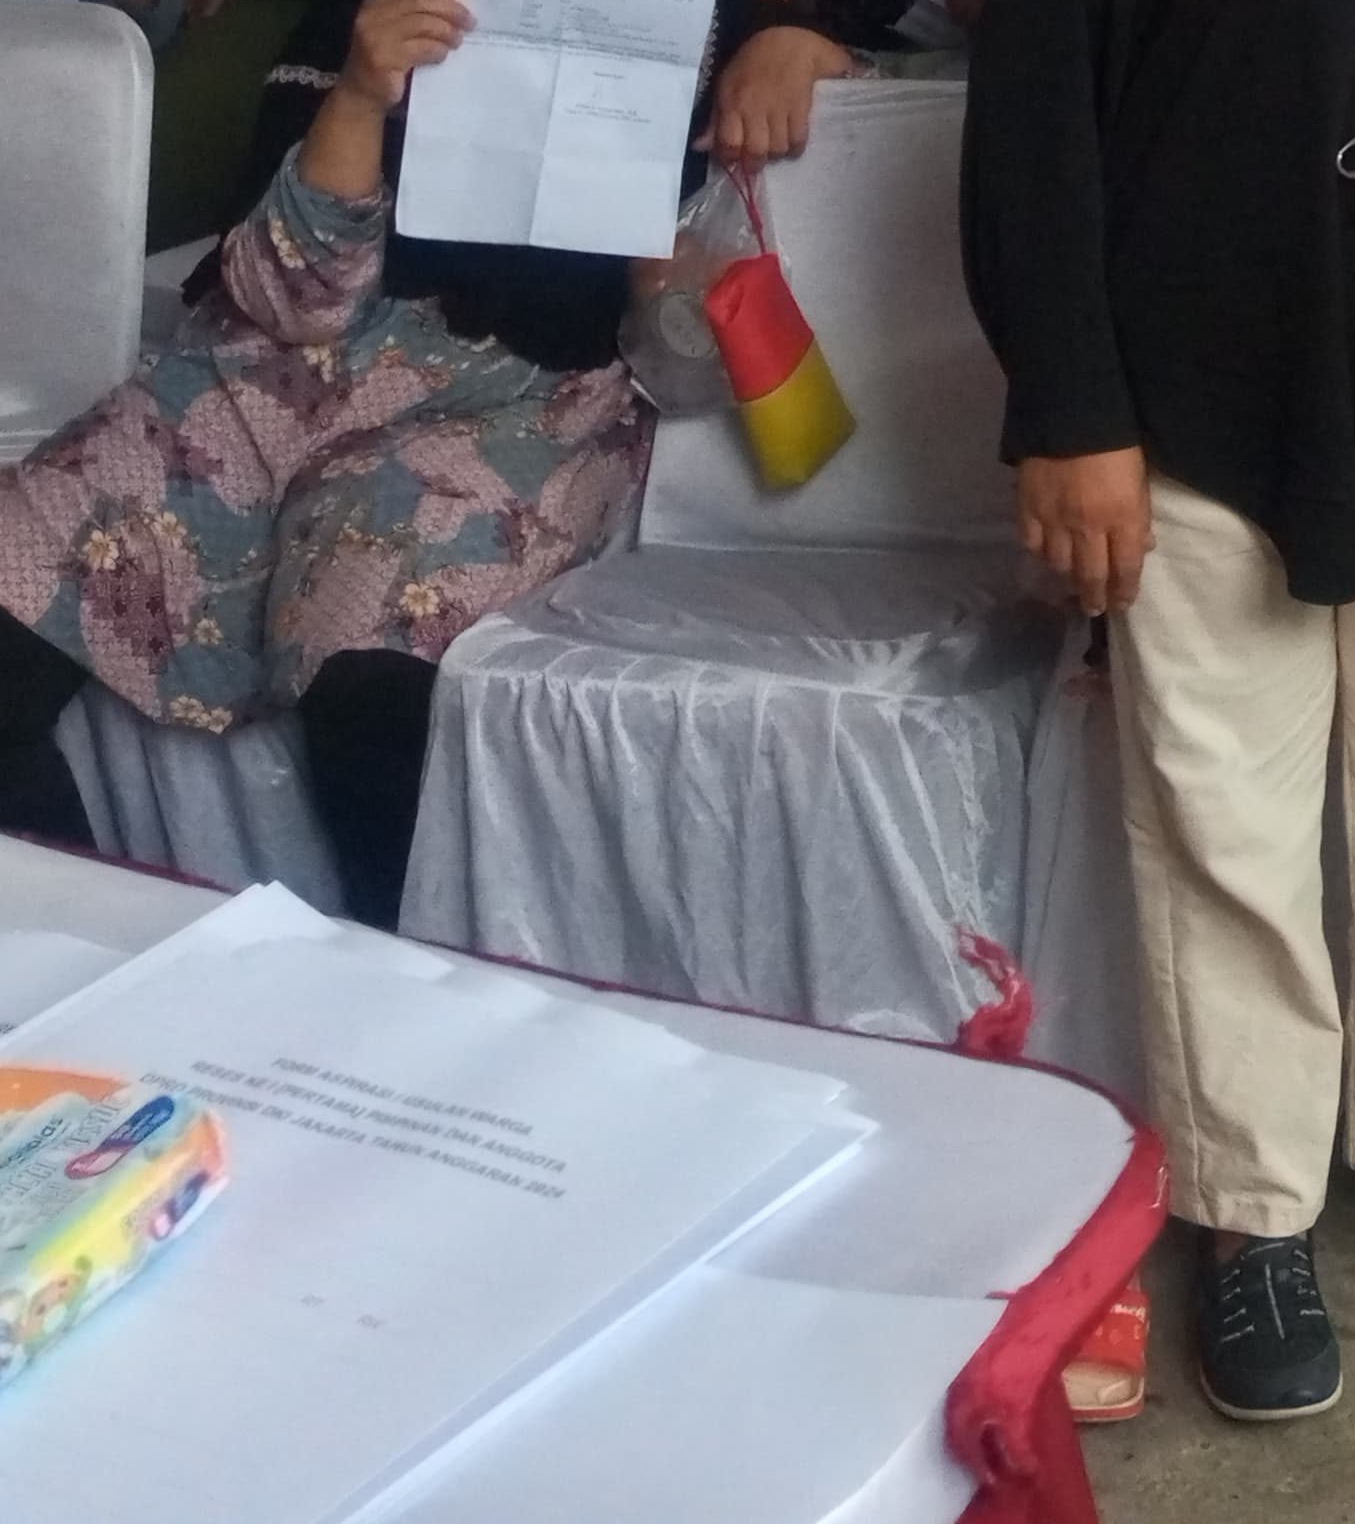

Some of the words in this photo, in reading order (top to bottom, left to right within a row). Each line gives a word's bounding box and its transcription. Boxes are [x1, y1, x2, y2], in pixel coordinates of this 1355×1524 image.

[290, 1114, 367, 1144] JAKARTA
[425, 1149, 525, 1188] ANGGARAN
[480, 1139, 567, 1174] ANGGOTA
